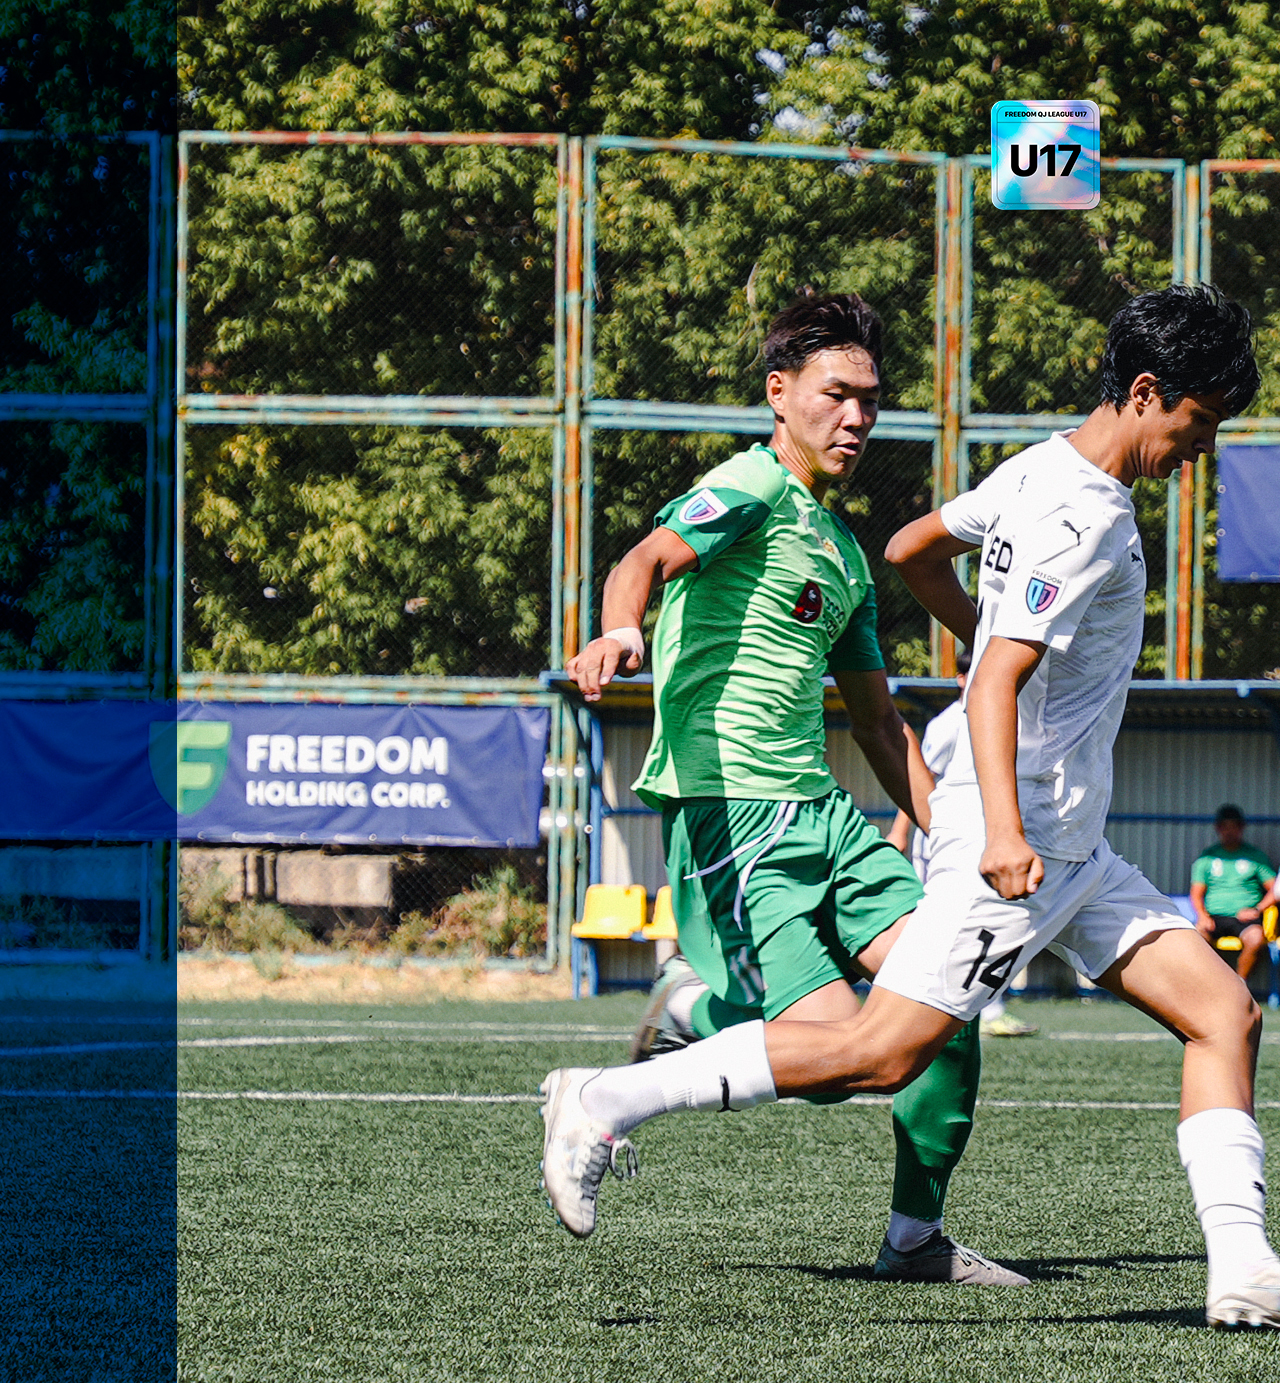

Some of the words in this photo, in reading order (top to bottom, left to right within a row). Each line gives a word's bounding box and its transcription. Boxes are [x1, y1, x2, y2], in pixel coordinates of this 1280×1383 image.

[247, 734, 449, 775] FREEDOM
[246, 780, 370, 807] HOLDING
[371, 781, 452, 808] CORP.
[962, 928, 1025, 1000] 14
